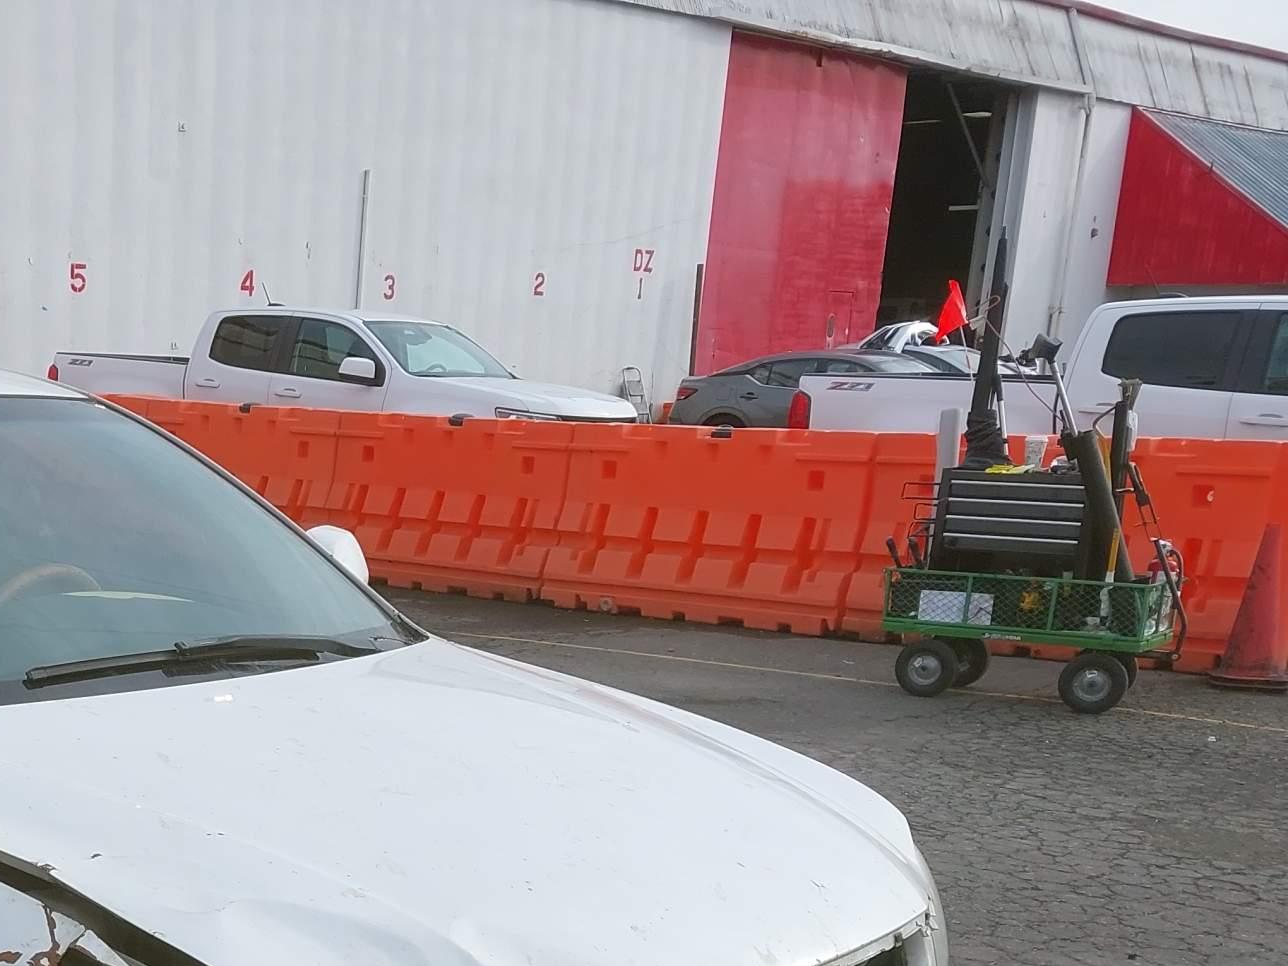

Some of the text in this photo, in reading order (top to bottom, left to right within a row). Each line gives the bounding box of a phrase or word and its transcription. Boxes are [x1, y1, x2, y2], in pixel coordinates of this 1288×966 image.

[633, 248, 655, 273] DZ
[70, 263, 87, 293] 5
[240, 269, 255, 297] 4
[383, 274, 395, 300] 3
[533, 272, 545, 296] 2
